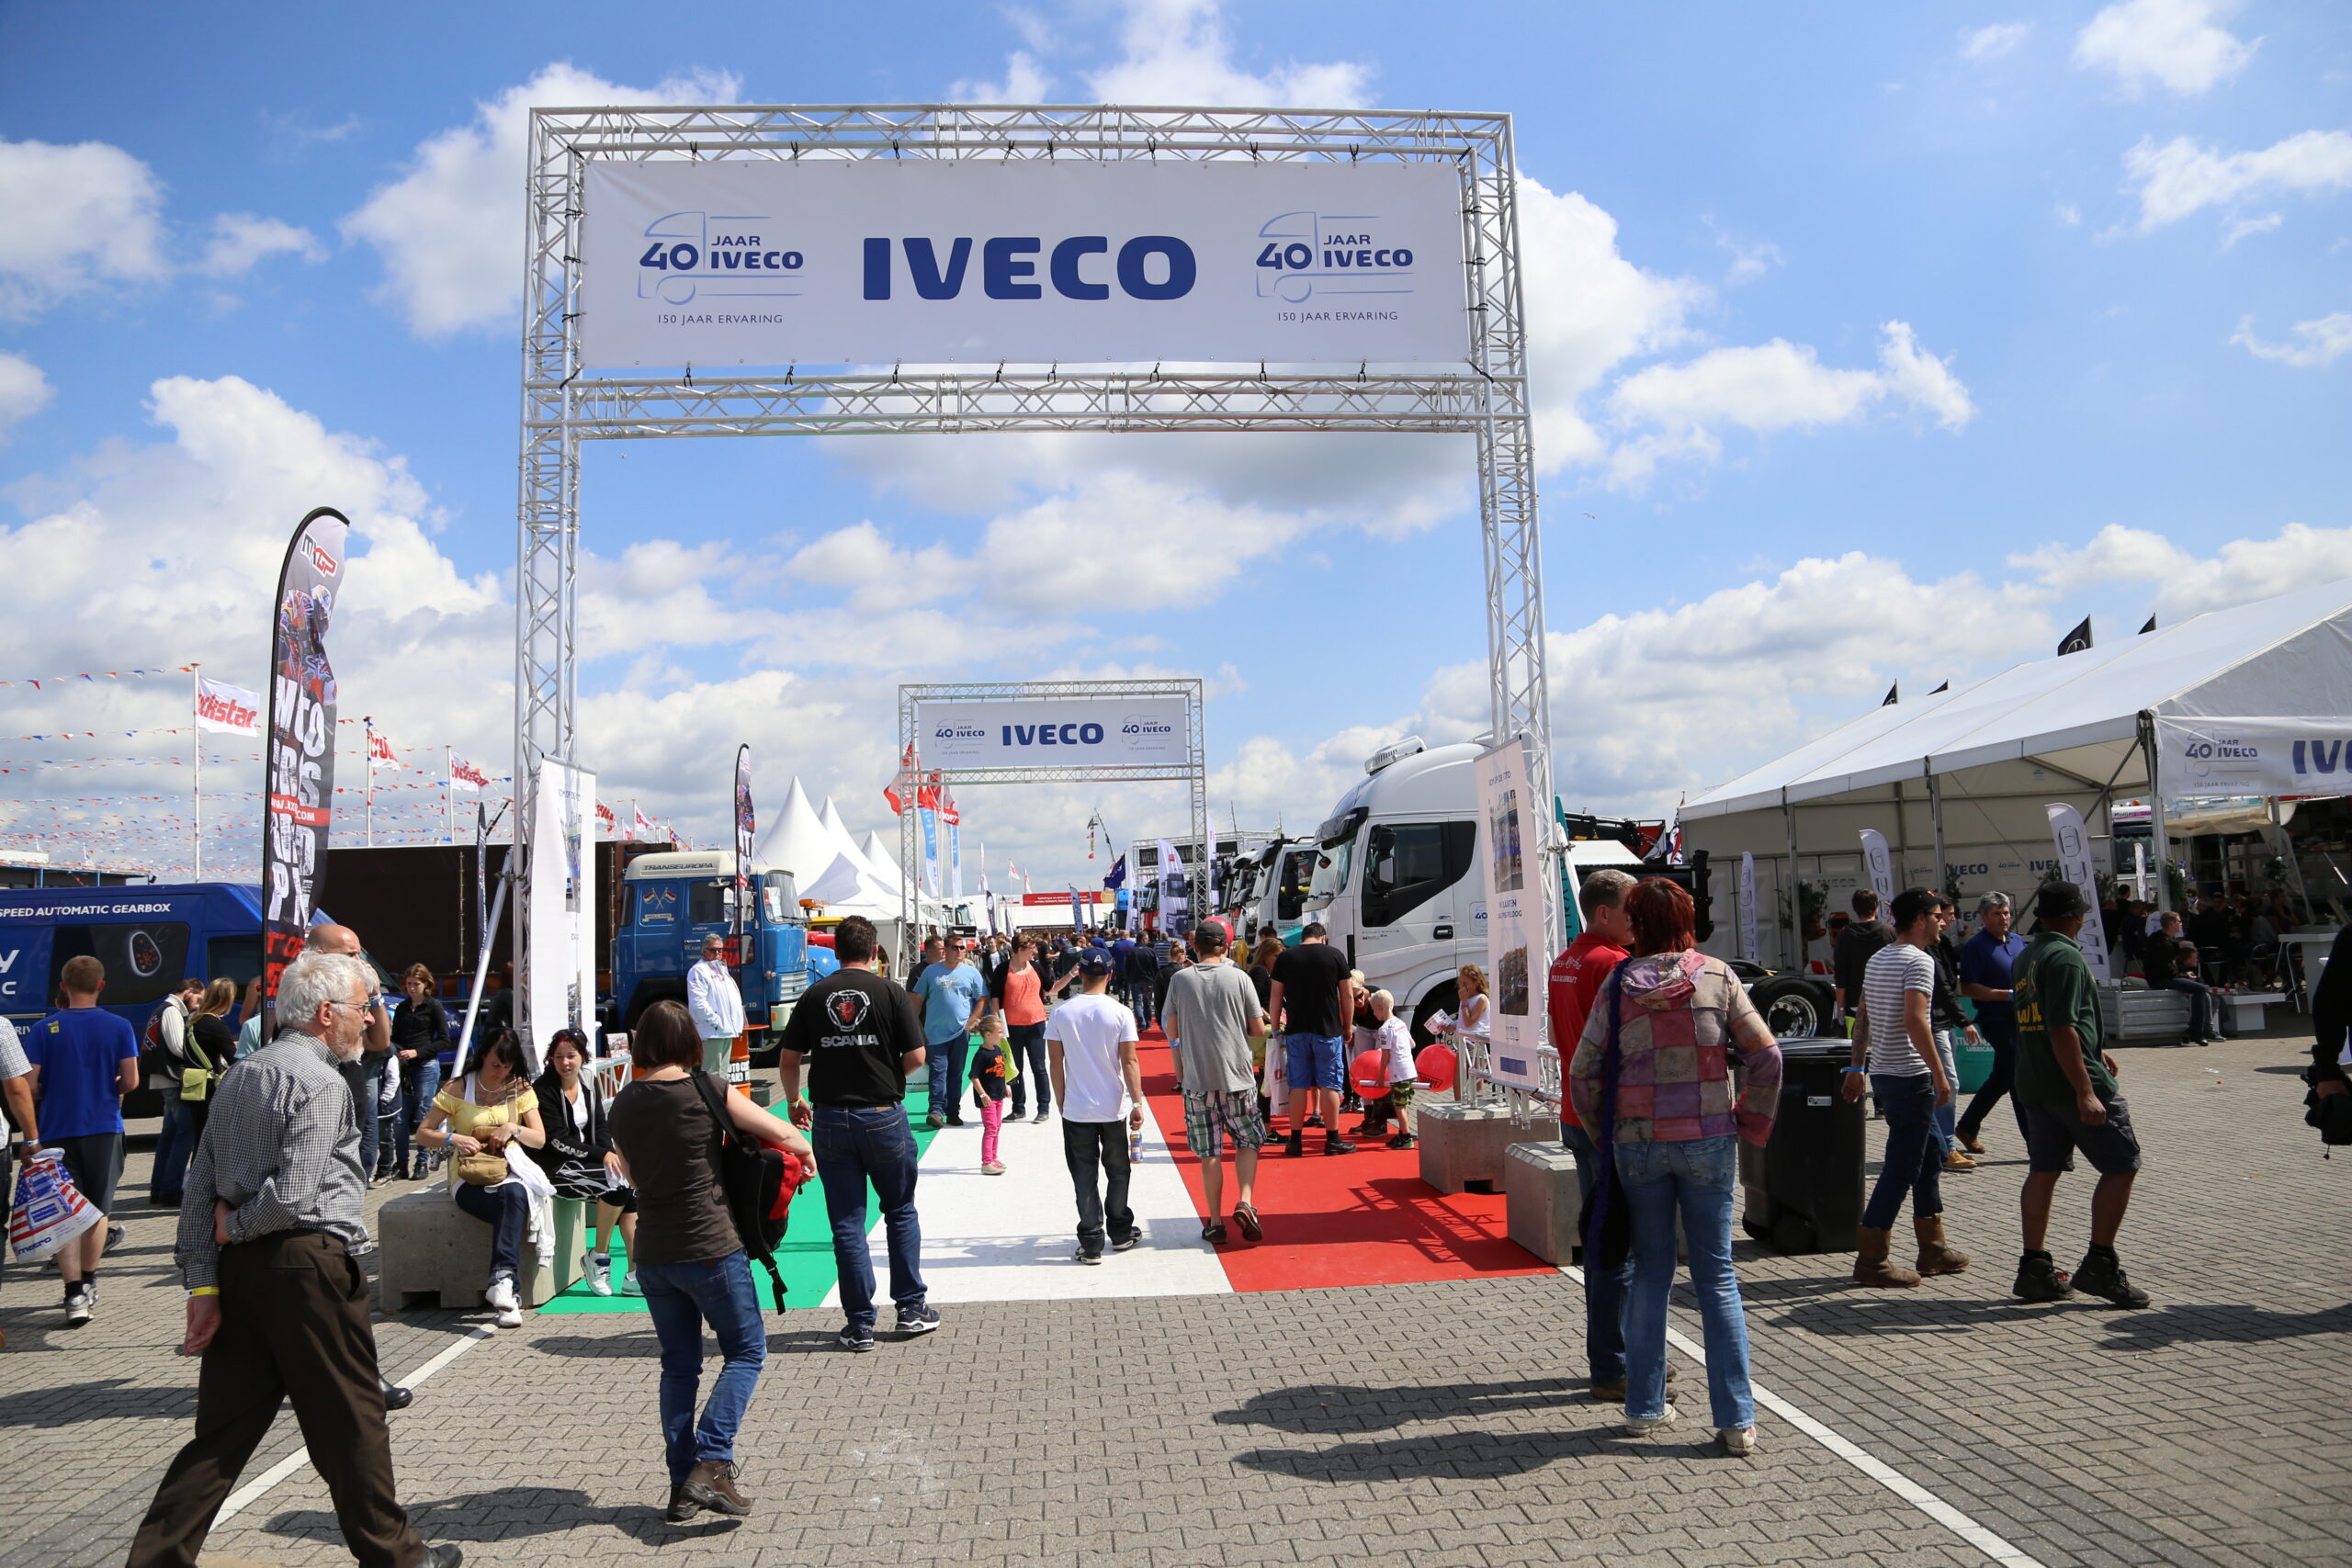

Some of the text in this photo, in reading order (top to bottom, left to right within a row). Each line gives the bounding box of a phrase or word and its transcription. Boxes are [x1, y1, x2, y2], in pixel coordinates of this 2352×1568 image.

[711, 236, 761, 246] JAAR
[1323, 235, 1371, 245] JAAR
[639, 243, 699, 270] 40
[711, 251, 804, 269] IVECO
[1256, 243, 1312, 270] 40
[1324, 249, 1413, 267] IVECO
[864, 235, 1196, 300] IVECO
[658, 315, 783, 326] 150 JAAR ERVARING
[1278, 311, 1397, 323] 150 JAAR ERVARING
[935, 728, 954, 739] 40
[1002, 723, 1104, 746] IVECO
[1122, 724, 1139, 733] 40
[2185, 743, 2212, 759] 40
[2218, 748, 2258, 758] IVECO
[644, 863, 714, 871] TRANSEUROPA
[1955, 864, 1988, 874] ECO
[36, 905, 109, 917] AUTOMATIC
[112, 903, 171, 914] GEARBOX
[820, 1034, 880, 1047] SCANIA
